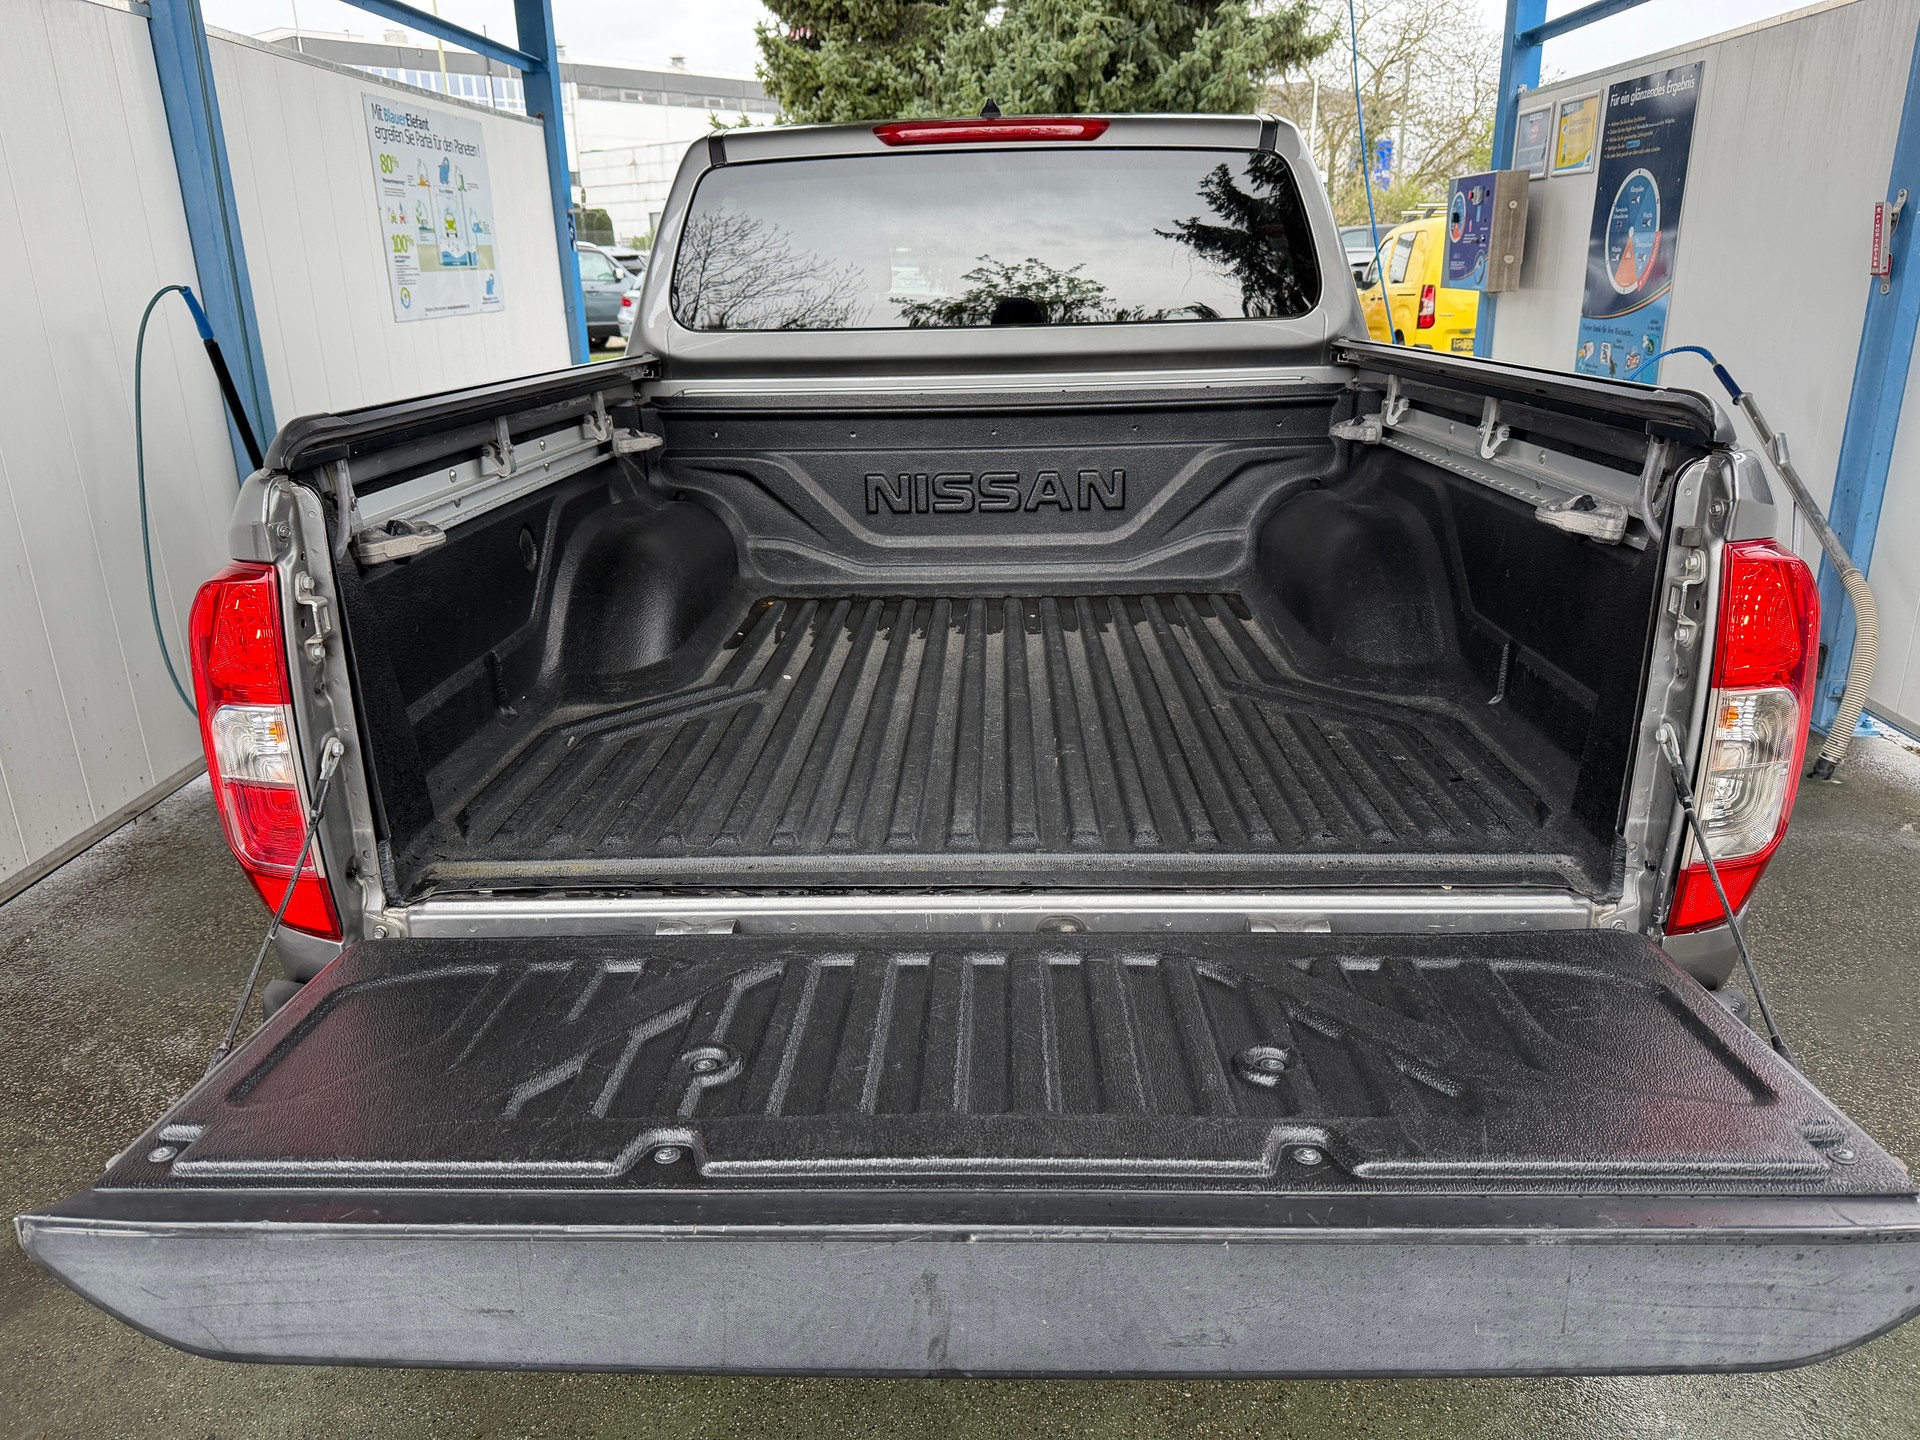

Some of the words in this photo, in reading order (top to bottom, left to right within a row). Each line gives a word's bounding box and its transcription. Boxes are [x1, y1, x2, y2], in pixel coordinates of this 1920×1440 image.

[1610, 93, 1620, 107] Für
[1620, 90, 1629, 105] ein
[1629, 82, 1665, 106] glänzendes
[1666, 75, 1695, 96] Ergebnis
[371, 102, 383, 121] Mit
[374, 125, 404, 144] ergreifen
[404, 128, 415, 146] Sie
[415, 130, 433, 149] Partei
[433, 133, 442, 151] für
[442, 136, 454, 153] den
[379, 153, 400, 174] 80%
[392, 233, 414, 254] 100%
[865, 468, 1126, 515] NISSAN
